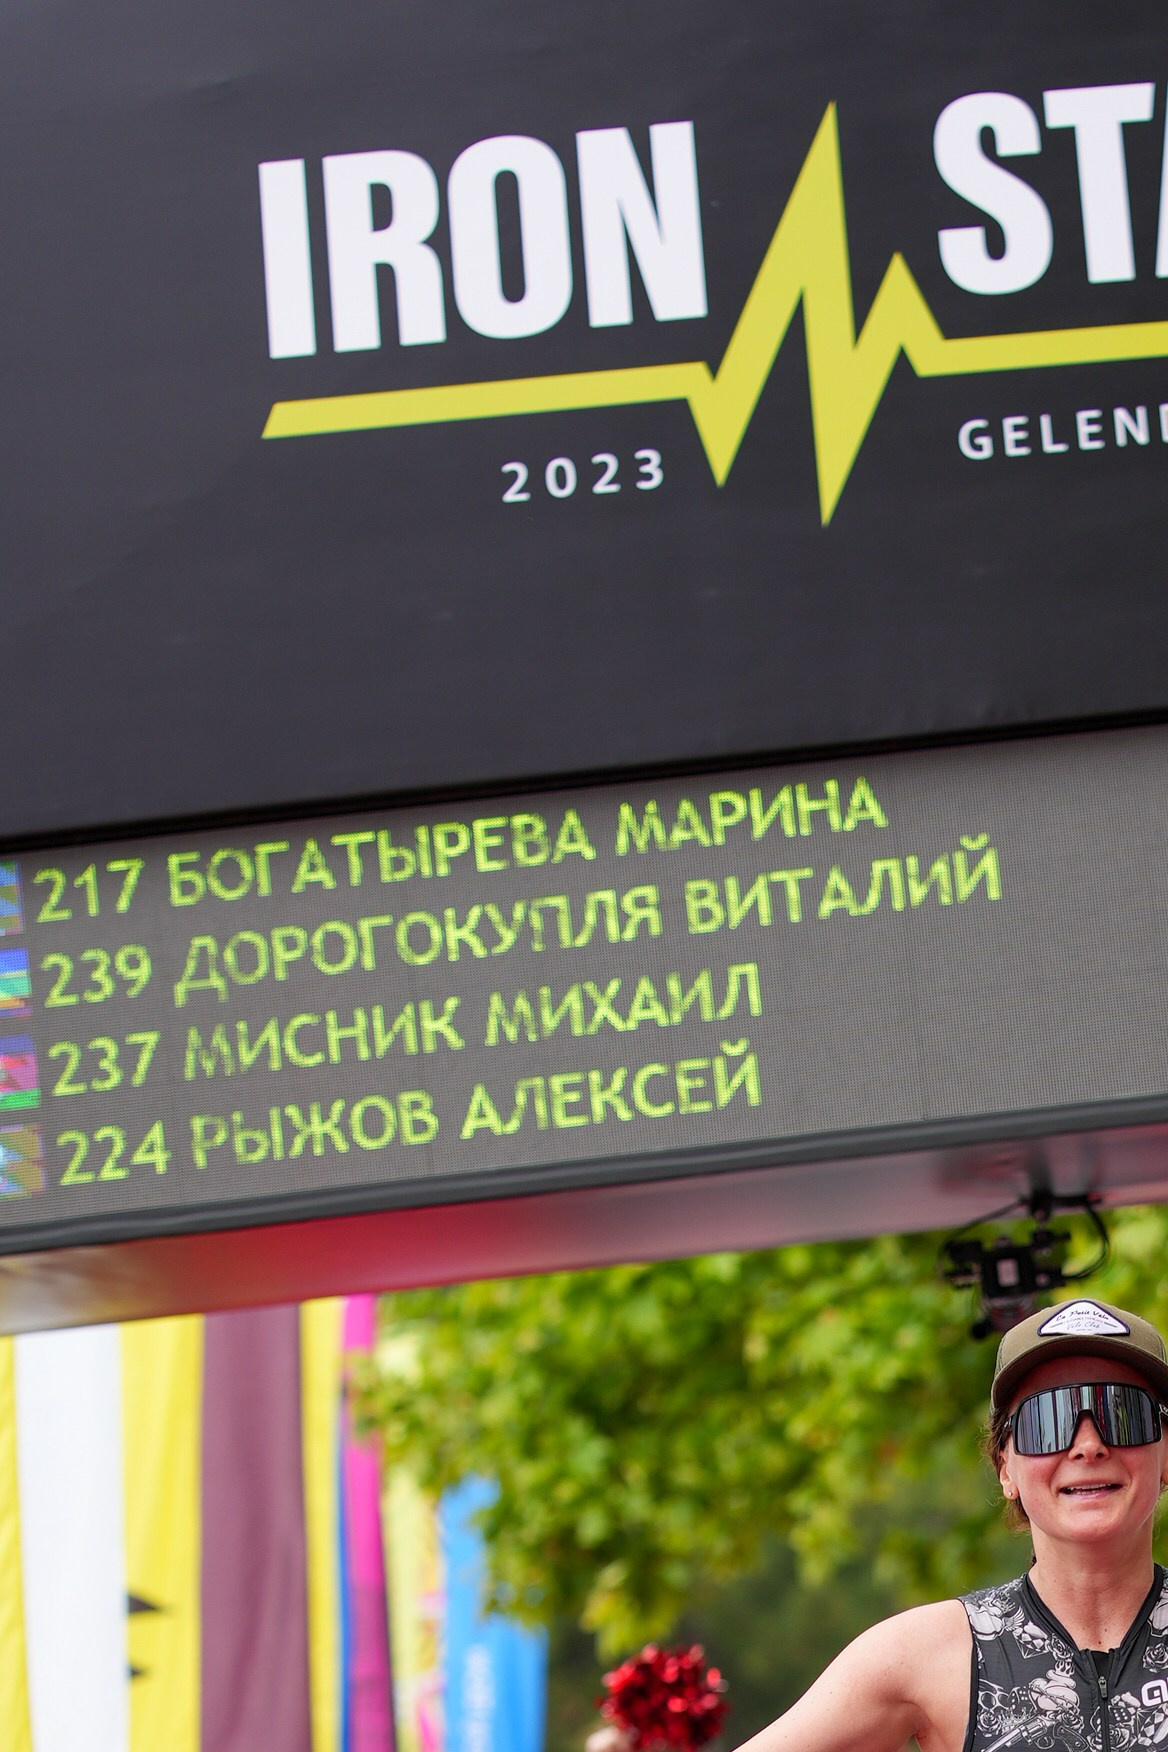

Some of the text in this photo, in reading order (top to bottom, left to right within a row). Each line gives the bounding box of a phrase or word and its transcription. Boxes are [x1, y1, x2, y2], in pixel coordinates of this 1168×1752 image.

[258, 121, 708, 360] IRON
[502, 449, 664, 503] 2023
[34, 777, 889, 923] 217 БОГАТЫРЕВА МАРИНА
[42, 833, 1002, 1008] 239 ДОРОГОКУПЛЯ ВИТАЛИЙ
[48, 961, 763, 1096] 237 МИСНИК МИХАИЛ
[57, 1037, 762, 1187] 224 РЫЖОВ АЛЕКСЕЙ
